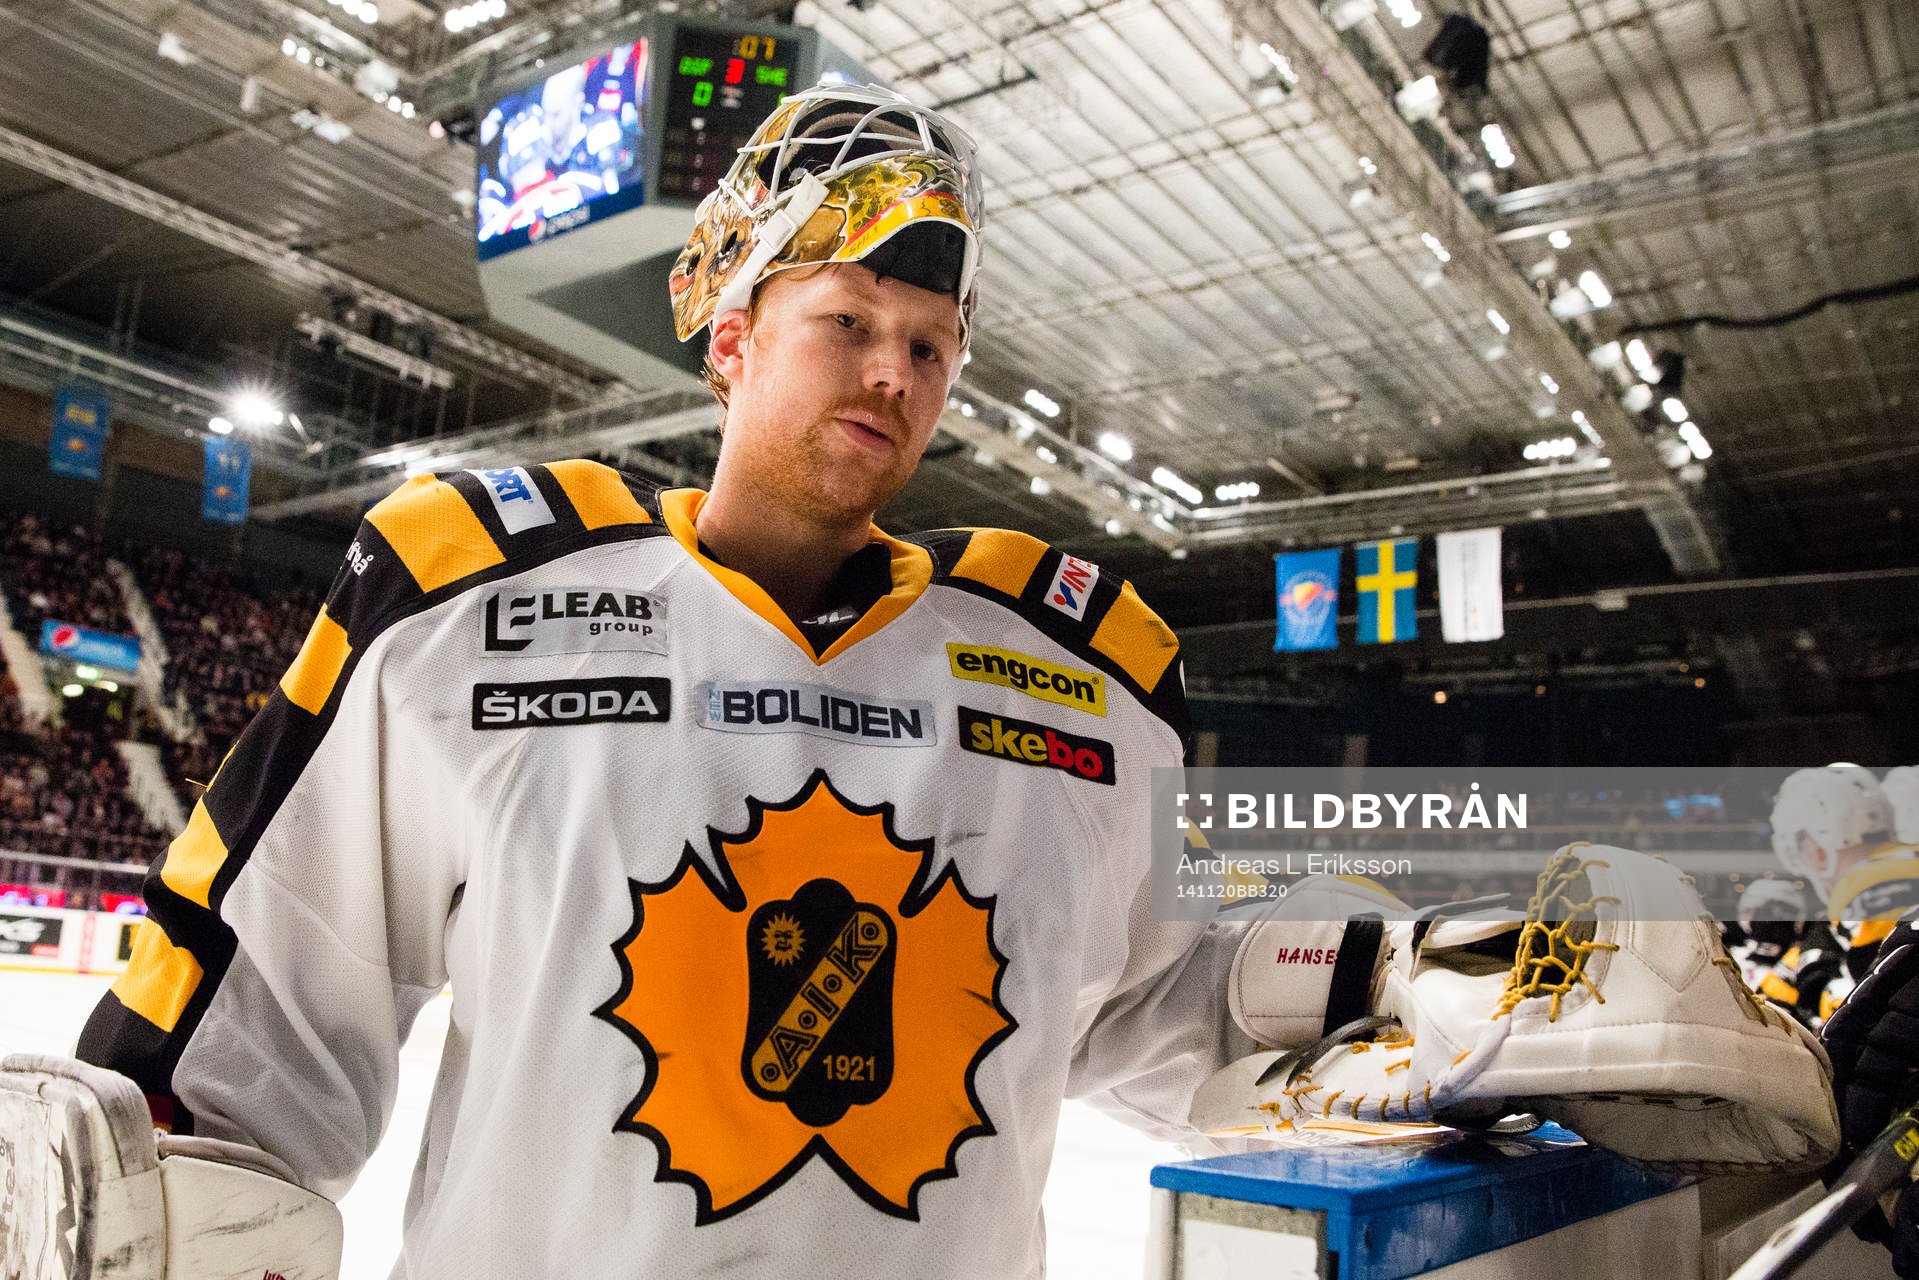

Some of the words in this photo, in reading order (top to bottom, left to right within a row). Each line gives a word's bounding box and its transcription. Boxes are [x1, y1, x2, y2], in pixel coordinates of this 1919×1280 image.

[542, 592, 652, 620] LEAB
[589, 621, 654, 636] group
[956, 652, 1096, 703] engcon
[482, 690, 660, 723] ŠKODA
[722, 688, 923, 739] BOLIDEN
[970, 718, 1104, 778] skebo
[1277, 947, 1338, 965] HANSE
[823, 1054, 876, 1081] 1921
